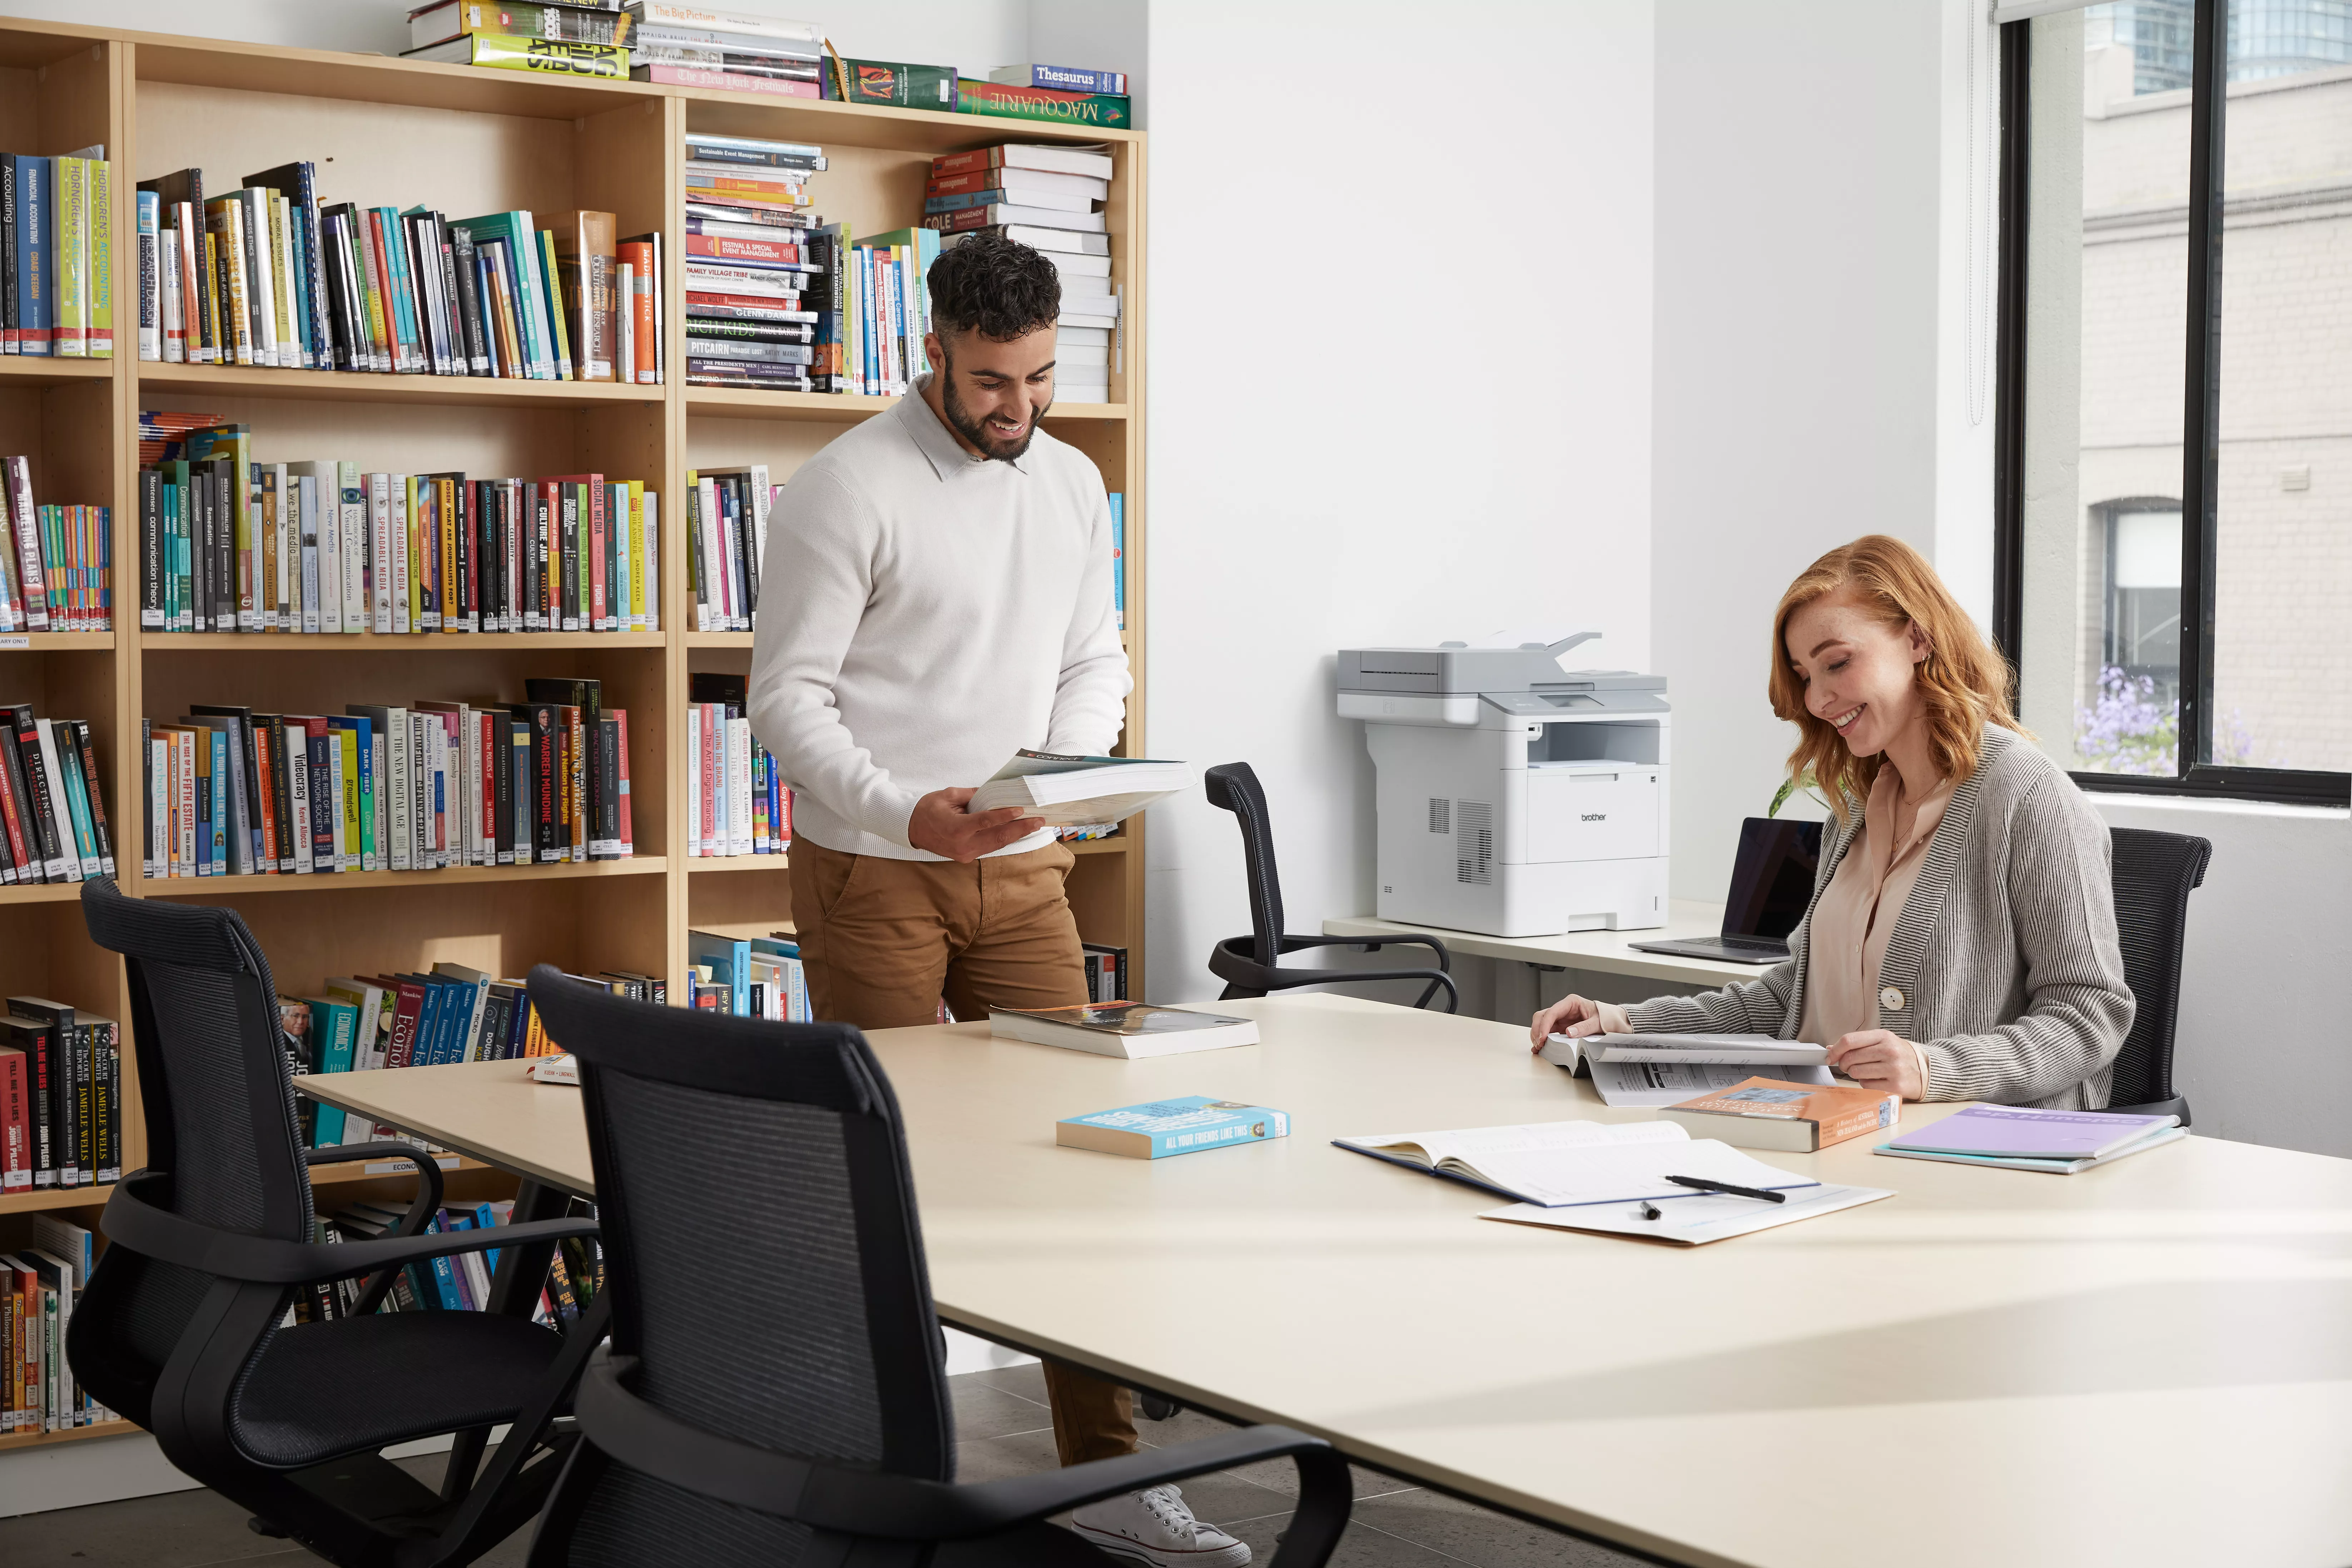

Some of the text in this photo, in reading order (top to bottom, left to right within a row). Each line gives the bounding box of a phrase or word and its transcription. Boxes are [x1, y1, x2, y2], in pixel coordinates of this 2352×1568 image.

[654, 5, 715, 22] The Big Picture
[678, 69, 794, 94] The New York Festivals
[1037, 67, 1095, 85] Thesaurus
[990, 91, 1099, 121] MACQUARIE
[945, 154, 972, 167] management
[3, 165, 13, 223] Accounting
[28, 169, 38, 244] FINANCIAL ACCOUNTING
[955, 209, 984, 221] MANAGEMENT
[98, 169, 108, 309] HORNGREN'S ACCOUNTING
[722, 241, 745, 249] FESTIVAL
[741, 249, 779, 258] MANAGEMENT
[31, 273, 39, 299] DEEGAN
[146, 238, 158, 325] RESEARCH DESIGN
[360, 299, 369, 322] Media
[691, 342, 729, 355] PITCAIRN
[180, 486, 188, 537] Communication
[289, 494, 295, 507] we
[594, 479, 602, 534] SOCIAL MEDIA
[16, 493, 34, 549] MARKETING
[378, 516, 386, 564] SPREADABLE
[539, 507, 548, 562] CULTURE JAM
[148, 582, 157, 610] theory
[574, 759, 580, 768] IN
[33, 753, 51, 818] DIRECTING
[395, 779, 404, 810] DIGITAL
[561, 787, 568, 796] by
[294, 754, 308, 848] Videocracy Kevin Allocca
[346, 779, 356, 823] groundswell
[542, 778, 550, 823] MUNDINE
[397, 812, 405, 829] AGE
[37, 1037, 45, 1051] TELL
[334, 1013, 352, 1051] ECONOMICS
[361, 1003, 376, 1068] economic principles
[38, 1064, 46, 1073] NO
[98, 1086, 106, 1126] JAMELLE
[1166, 1125, 1247, 1149] ALL YOUR FRIENDS LIKE THIS
[1844, 1126, 1857, 1135] ZEALAND
[1866, 1118, 1877, 1128] PACIFIC
[553, 1268, 566, 1278] MADE
[559, 1292, 571, 1301] JESS
[564, 1296, 575, 1305] HILL
[3, 1306, 11, 1348] Philosophy
